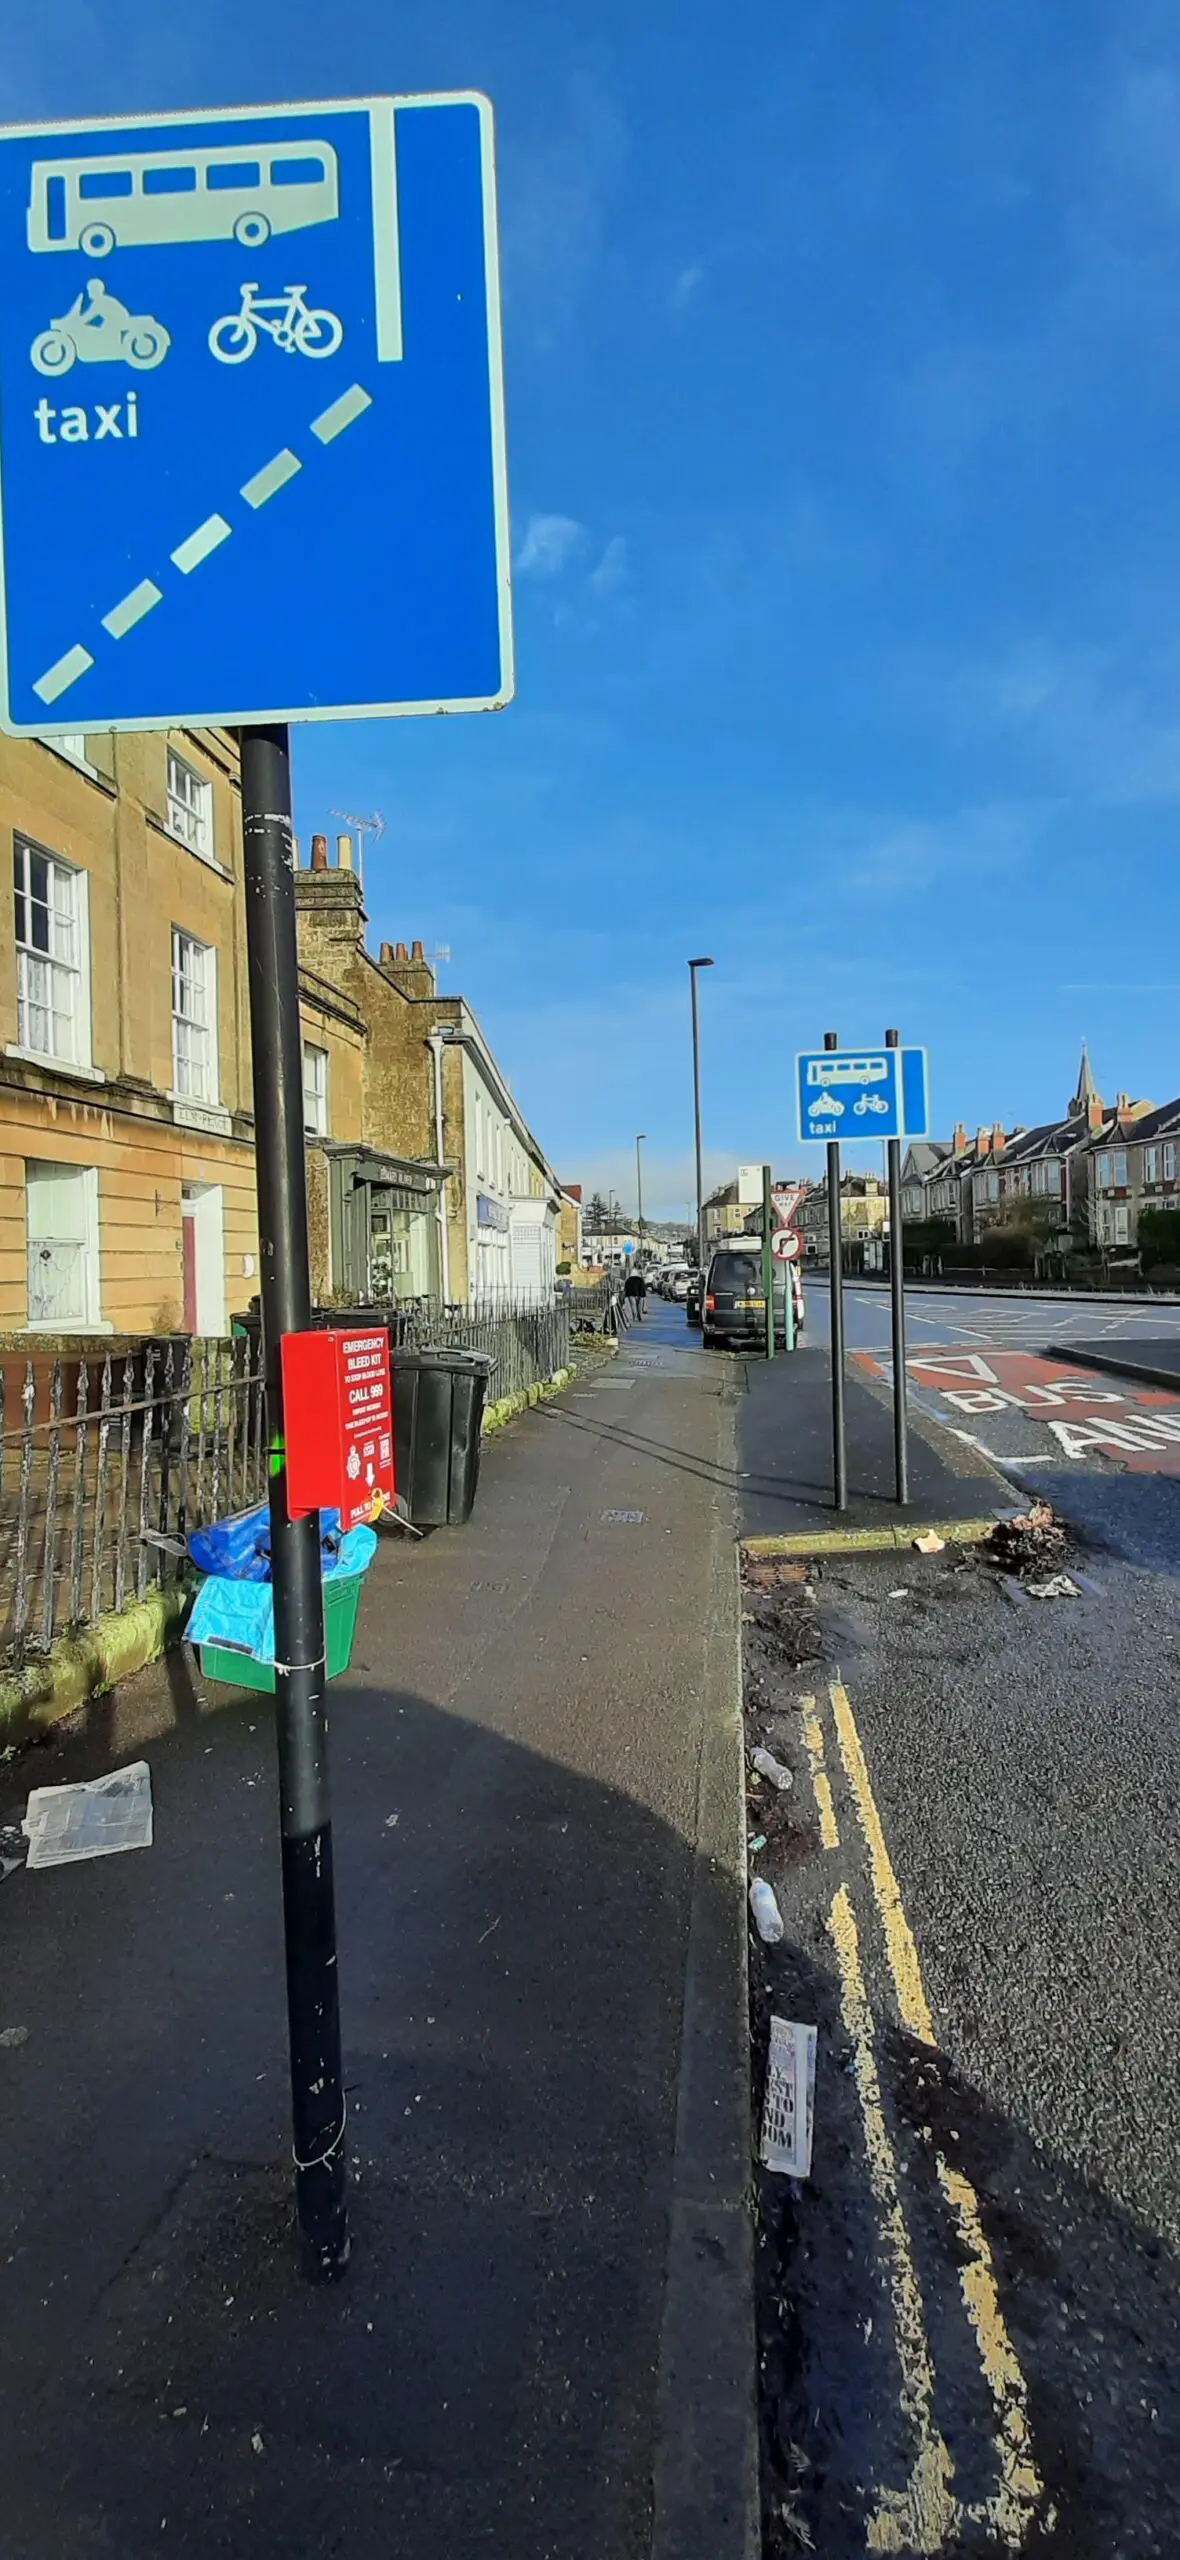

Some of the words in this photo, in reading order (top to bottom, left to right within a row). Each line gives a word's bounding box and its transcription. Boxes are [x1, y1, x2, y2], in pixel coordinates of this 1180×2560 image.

[33, 390, 138, 444] taxi
[809, 1119, 837, 1135] taxi
[343, 1336, 384, 1354] EMERGENCY
[347, 1355, 371, 1370] BLEED
[370, 1353, 382, 1366] KIT
[349, 1387, 369, 1404] CALL
[370, 1383, 384, 1398] 999
[939, 1374, 1126, 1413] BUS
[350, 1504, 364, 1519] PULL
